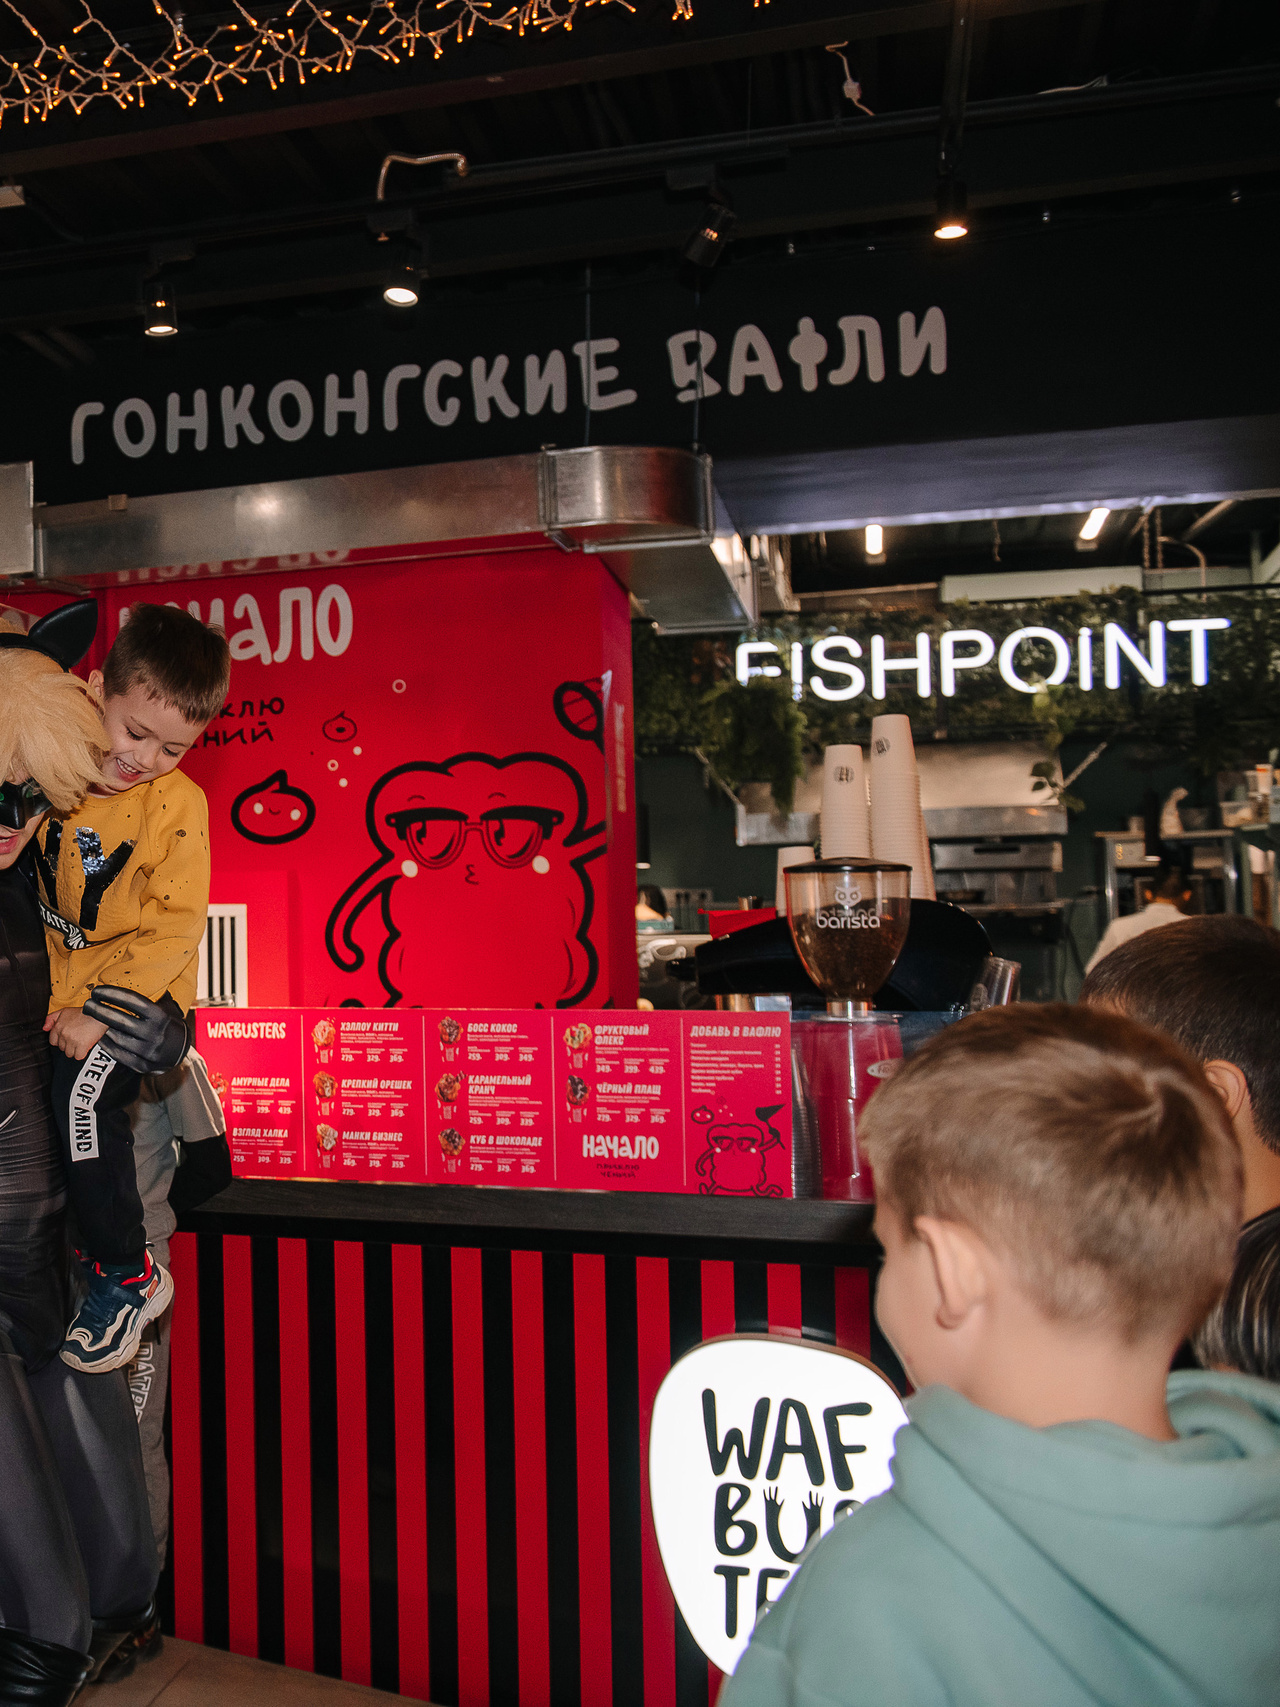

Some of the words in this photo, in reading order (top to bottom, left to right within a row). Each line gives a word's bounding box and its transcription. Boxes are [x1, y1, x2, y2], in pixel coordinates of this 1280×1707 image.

[70, 336, 637, 465] ГОНКОНГСКИЕ
[666, 306, 947, 403] ВАФЛИ
[816, 910, 881, 929] barista
[206, 1021, 286, 1039] WAFBUSTERS
[340, 1022, 372, 1032] ХЭЛЛОУ
[372, 1022, 399, 1032] КИТТИ
[467, 1023, 489, 1033] БОСС
[490, 1023, 518, 1033] КОКОС
[594, 1024, 650, 1035] ФРУКТОВЫЙ
[690, 1025, 731, 1038] ДОБАВЬ
[732, 1026, 740, 1038] В
[742, 1026, 782, 1038] ВАФЛЮ
[594, 1035, 625, 1046] ФЛЕКС
[84, 1050, 112, 1082] ATE
[231, 1077, 268, 1087] АМУРНЫЕ
[269, 1078, 290, 1088] ДЕЛА
[341, 1078, 378, 1089] КРЕПКИЙ
[380, 1080, 412, 1090] ОРЕШЕК
[468, 1074, 532, 1086] КАРАМЕЛЬНЫЙ
[468, 1085, 496, 1095] КРАНЧ
[596, 1083, 633, 1094] ЧЁРНЫЙ
[634, 1084, 662, 1096] ПЛАЩ
[74, 1106, 93, 1152] MIND
[232, 1128, 261, 1138] ВЗГЛЯД
[263, 1129, 288, 1138] ХАЛКА
[342, 1131, 371, 1141] МАНКИ
[372, 1131, 403, 1142] БИЗНЕС
[470, 1135, 487, 1144] КУБ
[488, 1136, 495, 1145] В
[496, 1136, 543, 1147] ШОКОЛАДЕ
[582, 1134, 660, 1160] НАЧАЛО
[701, 1388, 872, 1492] WAF
